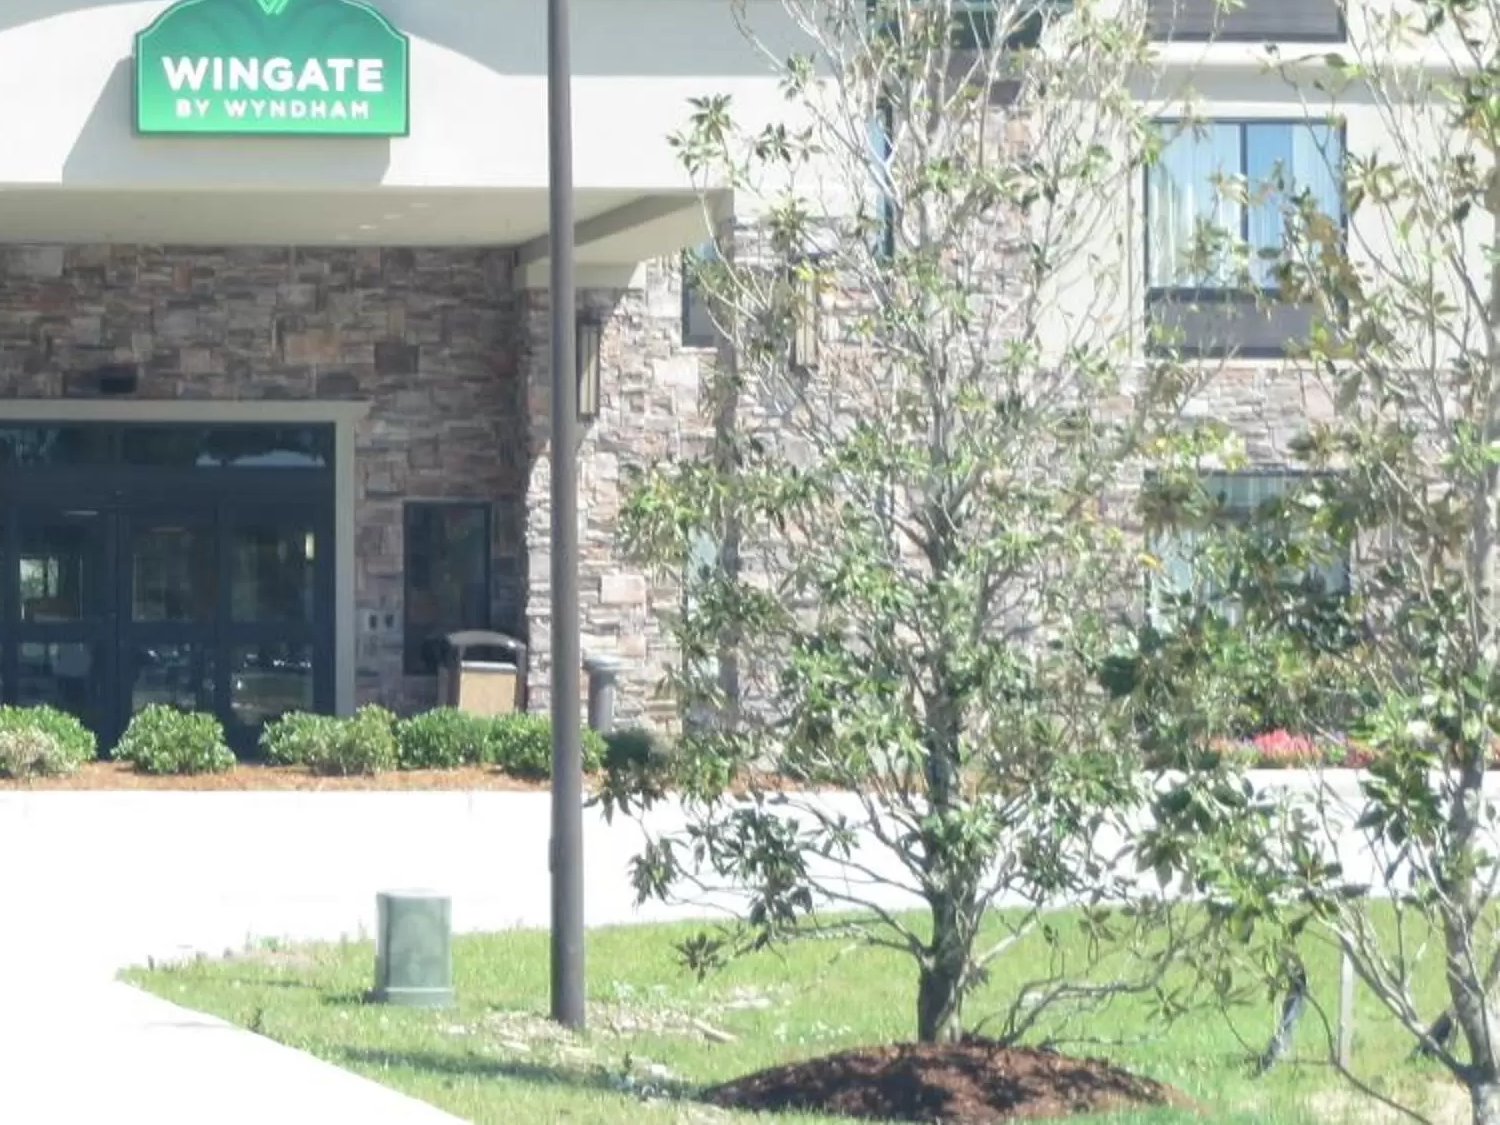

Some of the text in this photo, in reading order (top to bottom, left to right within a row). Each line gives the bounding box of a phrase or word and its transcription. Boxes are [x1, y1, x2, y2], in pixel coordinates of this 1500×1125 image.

[161, 57, 384, 92] WINGATE
[175, 99, 369, 120] BY WYNDHAM
